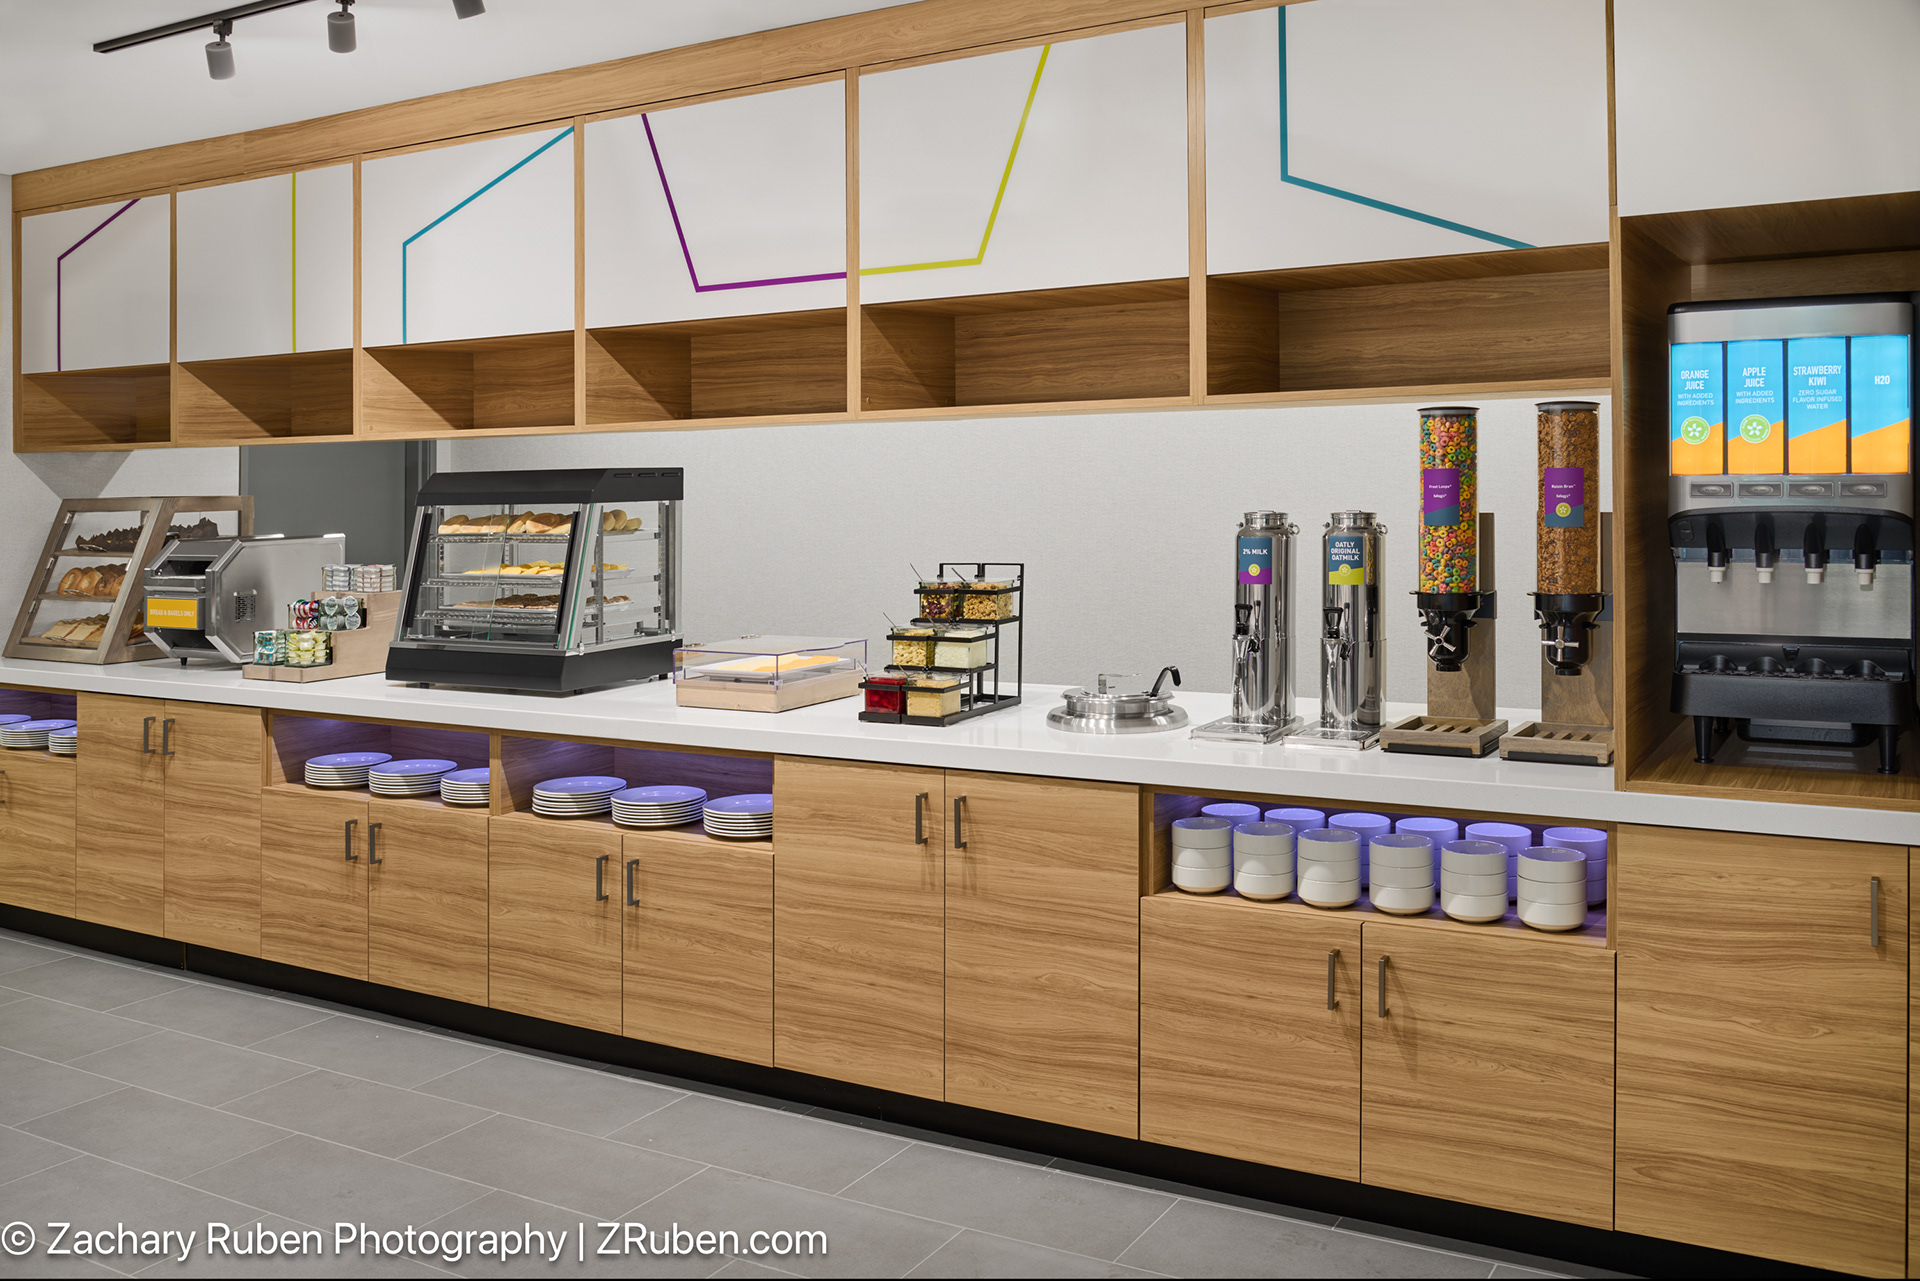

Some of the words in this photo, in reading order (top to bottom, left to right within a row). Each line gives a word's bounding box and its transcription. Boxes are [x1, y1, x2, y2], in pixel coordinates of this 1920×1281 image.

[1680, 369, 1709, 379] ORANGE
[1742, 367, 1766, 377] APPLE
[1793, 365, 1842, 376] STRAWBERRY
[1684, 380, 1704, 390] JUICE
[1743, 378, 1765, 388] JUICE
[1808, 376, 1827, 386] KIWI
